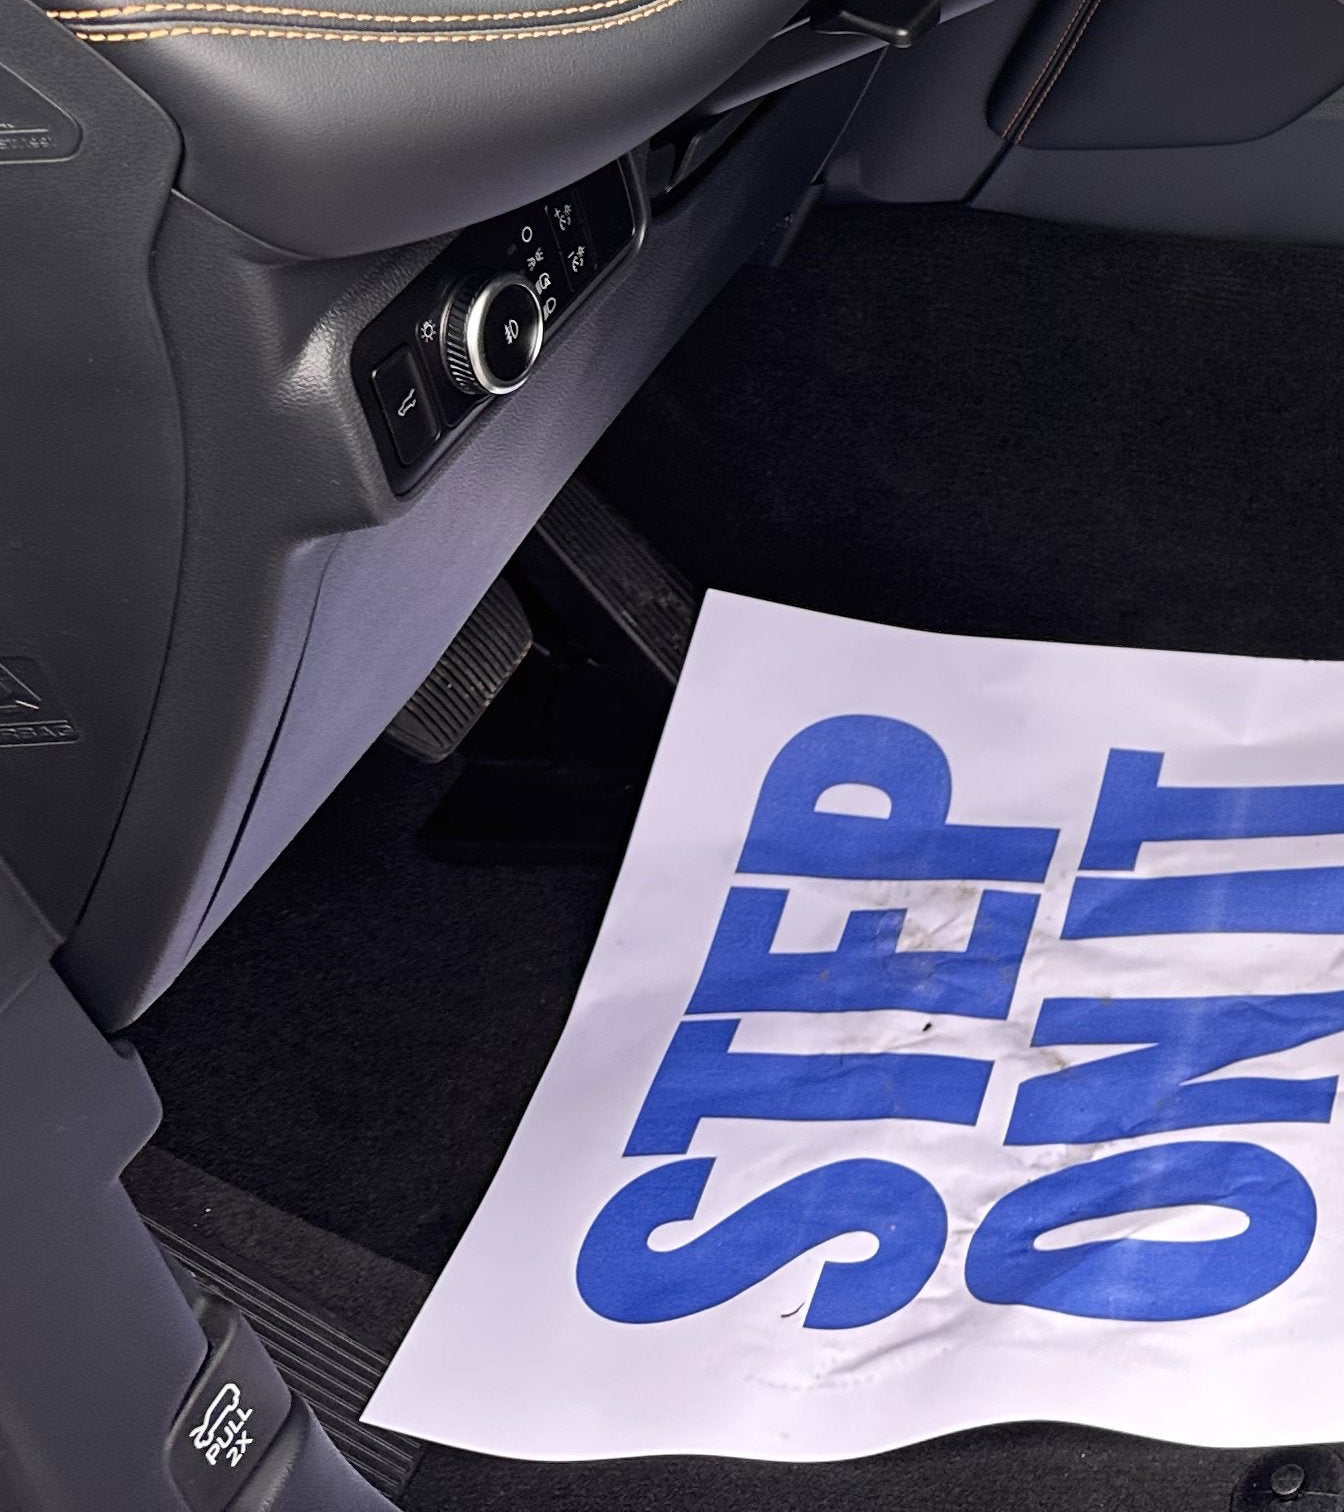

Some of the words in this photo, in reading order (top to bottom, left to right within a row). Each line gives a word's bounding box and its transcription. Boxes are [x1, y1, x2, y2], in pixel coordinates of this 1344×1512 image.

[576, 715, 1058, 1329] STEP
[206, 1408, 253, 1465] PULL
[226, 1430, 253, 1467] 2X
